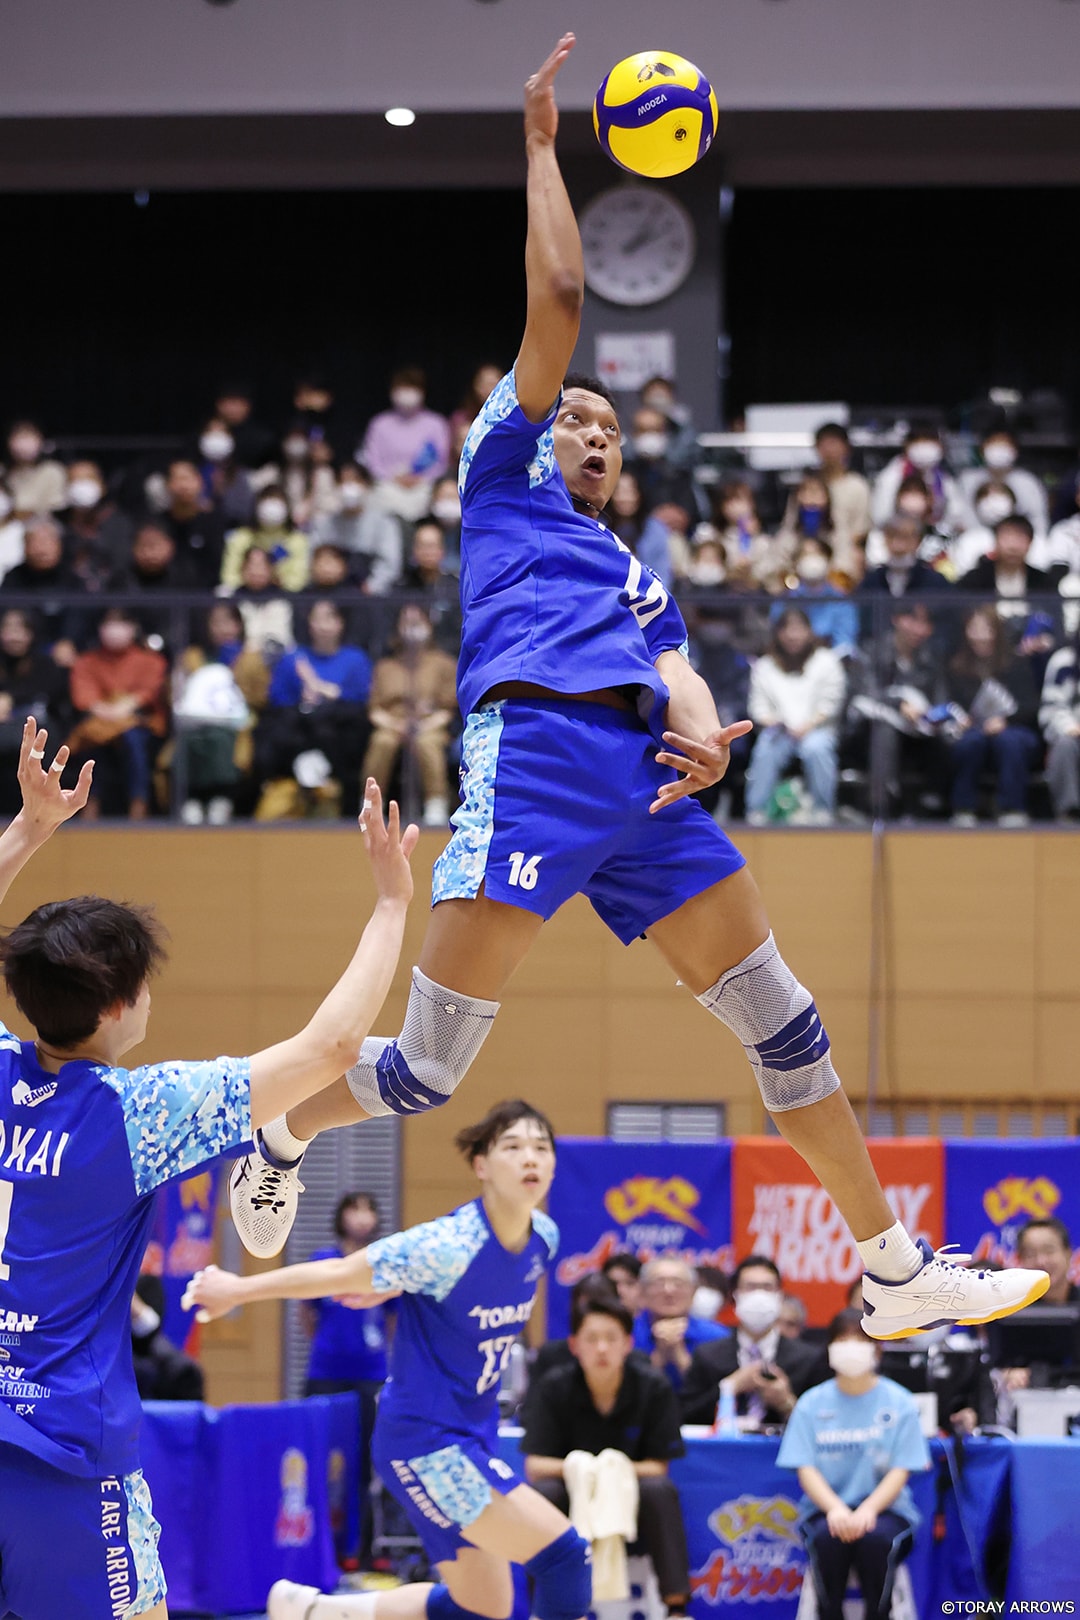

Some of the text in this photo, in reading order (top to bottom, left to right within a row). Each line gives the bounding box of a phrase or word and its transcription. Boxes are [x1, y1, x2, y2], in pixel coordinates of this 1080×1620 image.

[637, 93, 668, 117] V200W
[508, 851, 543, 890] 16
[101, 1475, 132, 1620] E ARE ARROW
